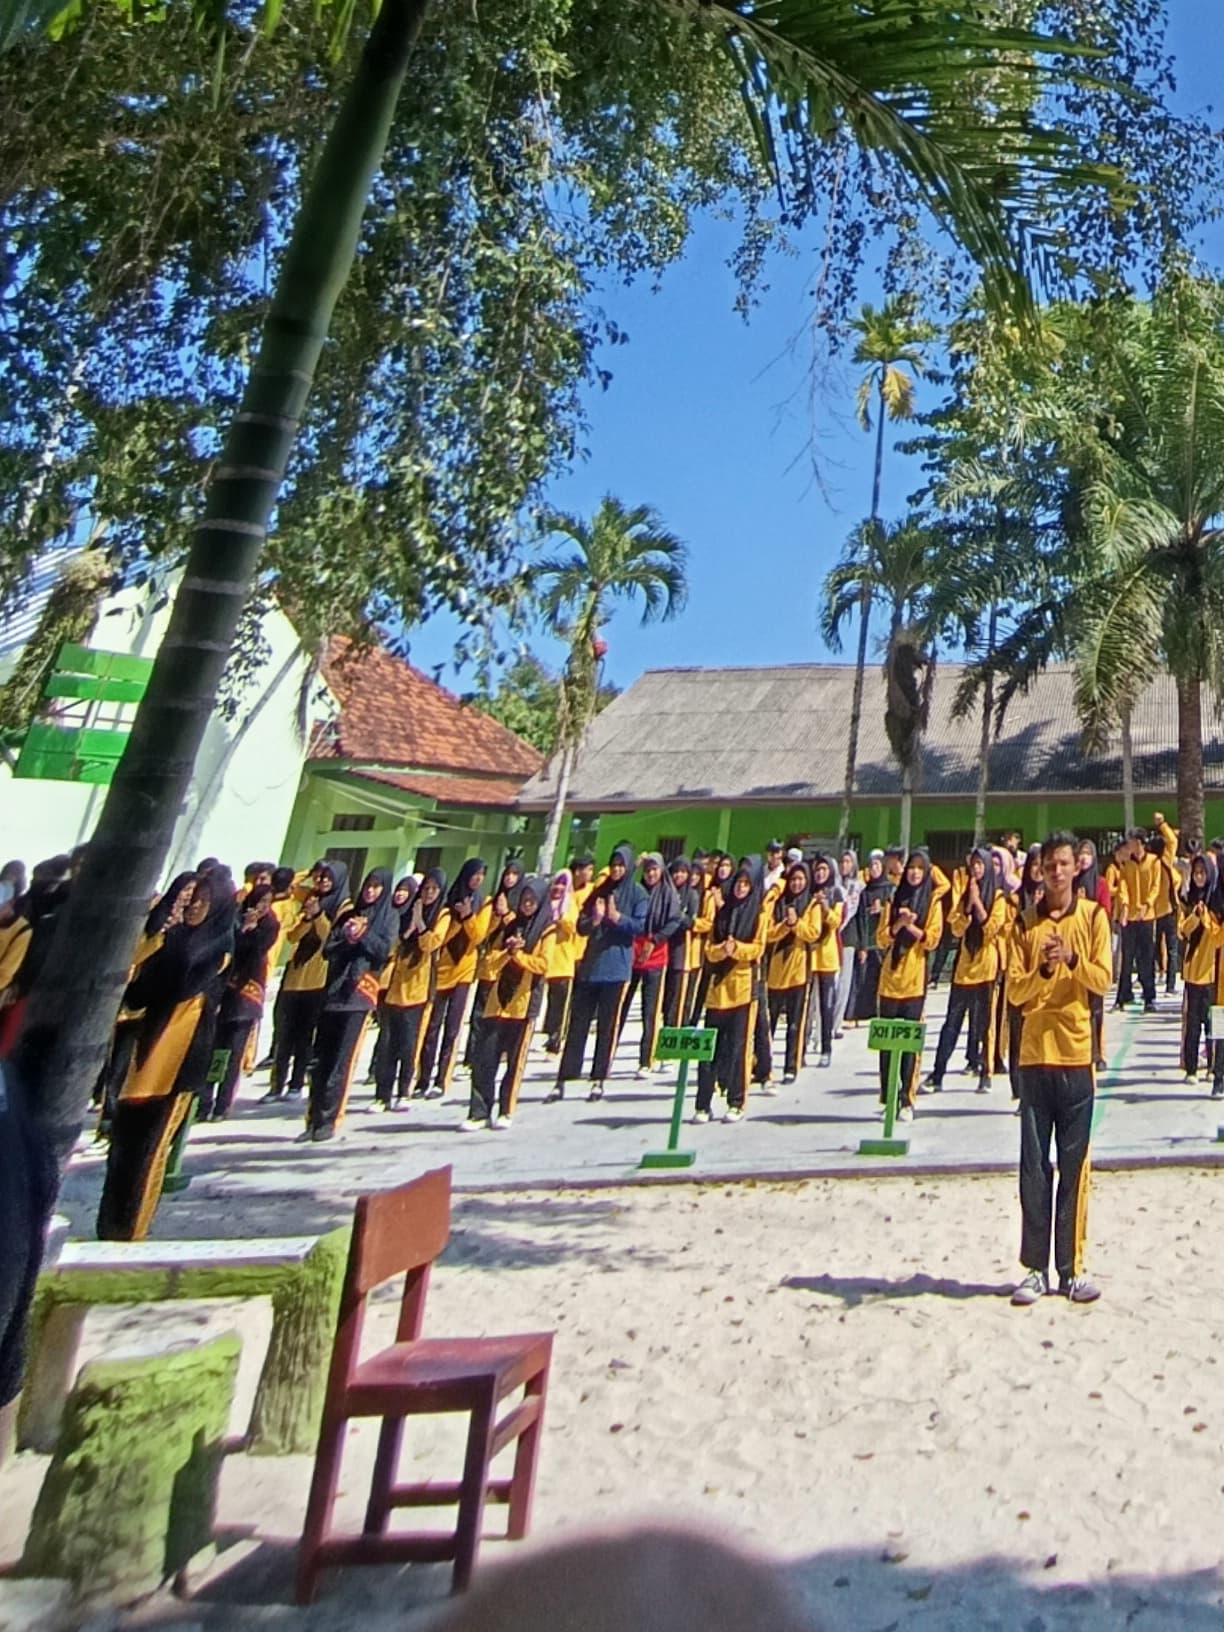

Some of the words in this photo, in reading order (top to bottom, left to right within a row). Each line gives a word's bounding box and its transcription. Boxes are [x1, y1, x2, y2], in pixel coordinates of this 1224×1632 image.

[872, 1026, 889, 1039] XII
[891, 1026, 911, 1039] IPS
[914, 1027, 922, 1039] 2
[661, 1036, 677, 1049] XII
[680, 1037, 700, 1050] IPS
[704, 1038, 711, 1051] 1
